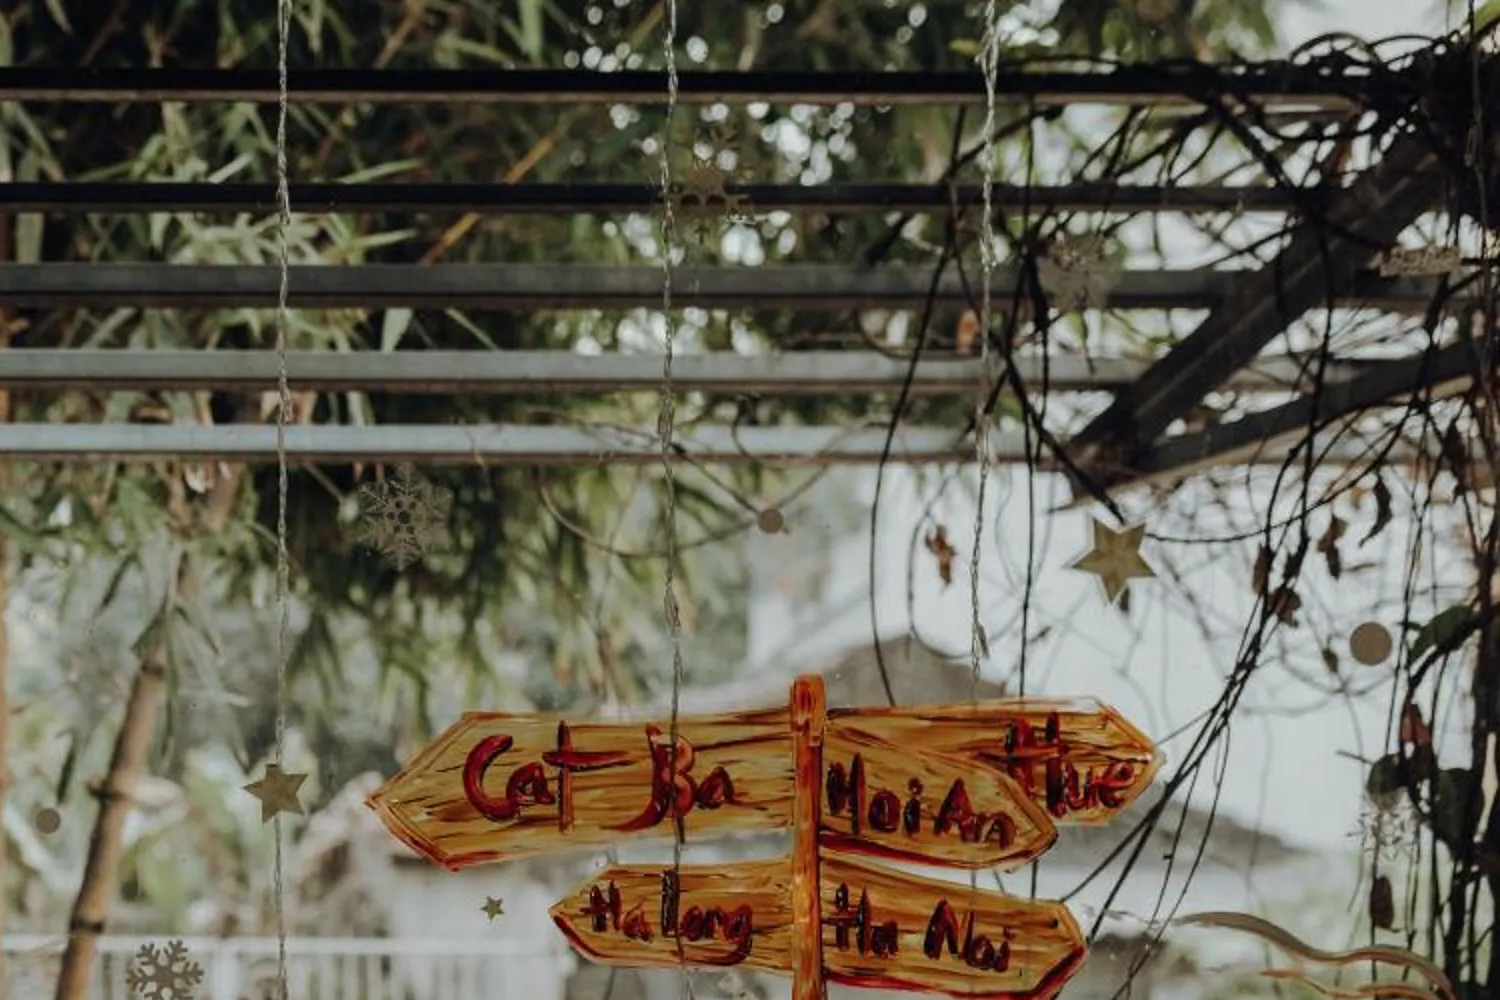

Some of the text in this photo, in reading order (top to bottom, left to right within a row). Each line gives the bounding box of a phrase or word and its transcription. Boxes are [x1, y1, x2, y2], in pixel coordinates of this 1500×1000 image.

[462, 716, 736, 834] Cat Ba
[825, 752, 1017, 850] Hoi An
